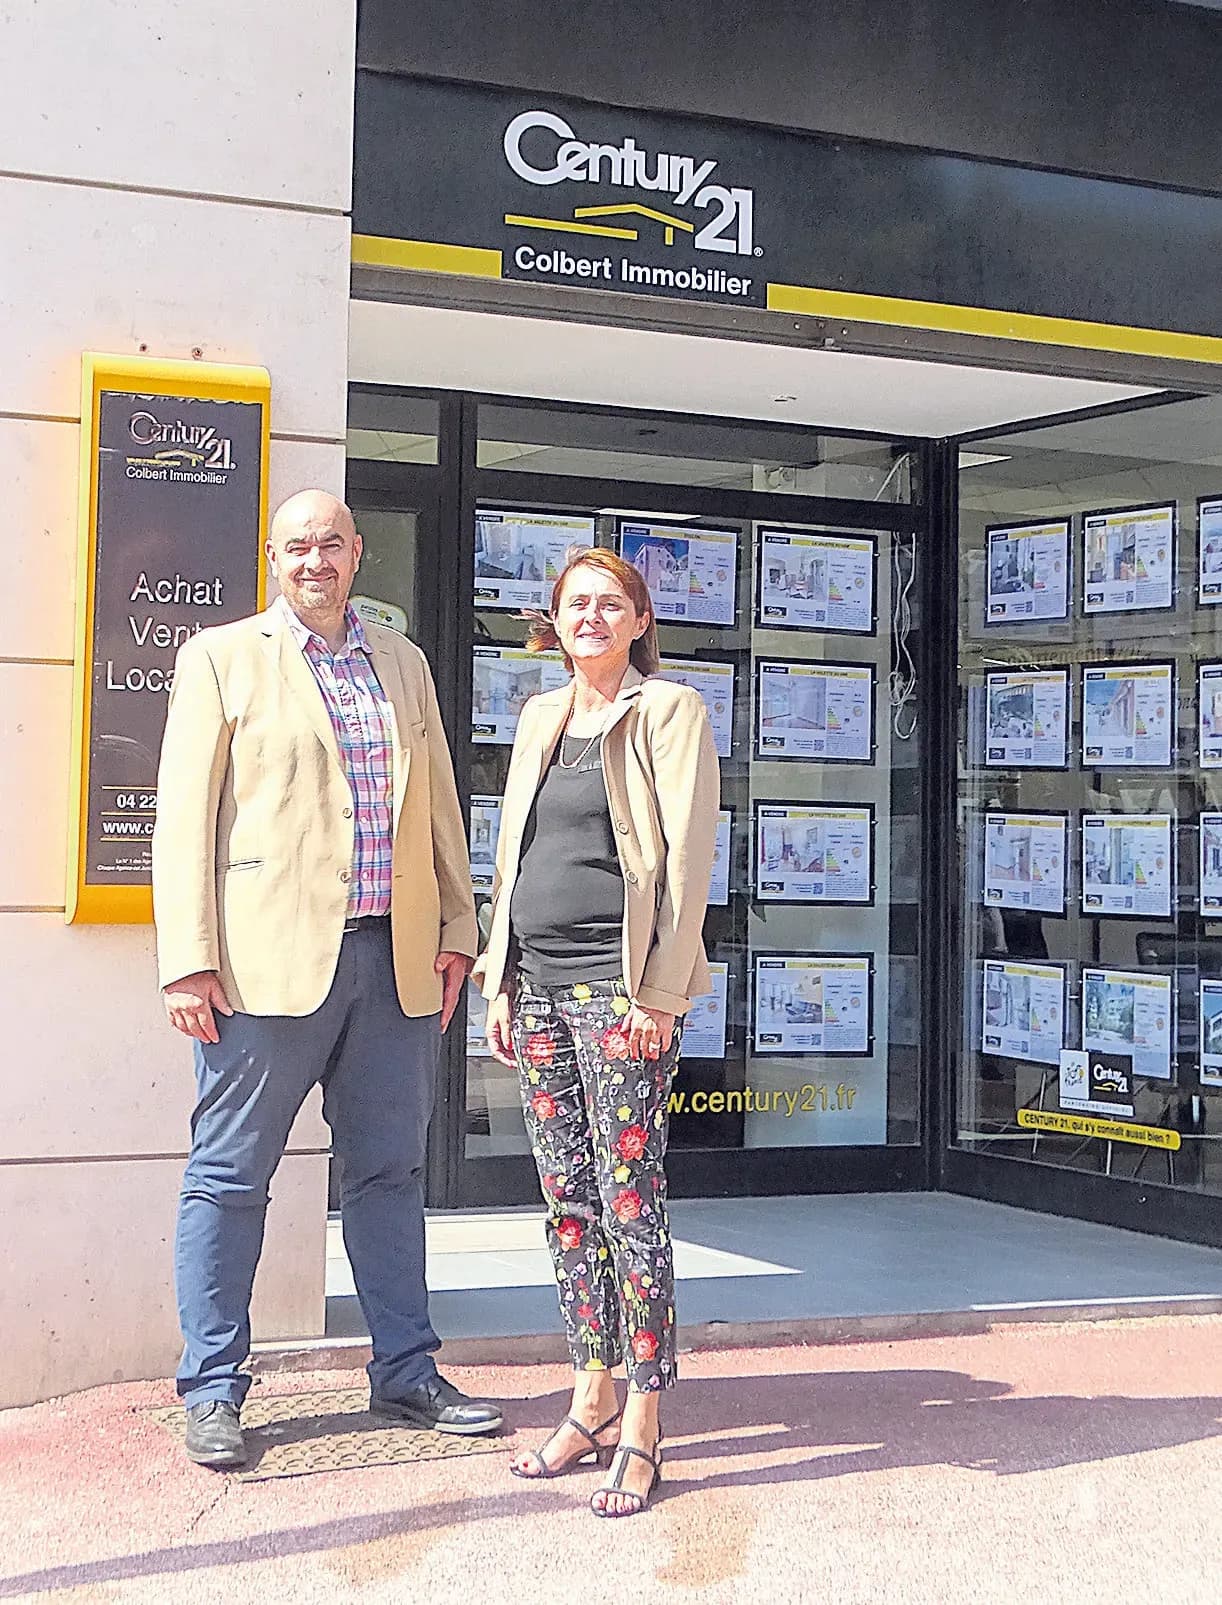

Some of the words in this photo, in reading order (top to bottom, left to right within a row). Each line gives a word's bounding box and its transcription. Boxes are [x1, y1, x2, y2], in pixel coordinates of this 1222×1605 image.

[504, 110, 717, 205] Century
[514, 246, 612, 280] Colbert
[621, 259, 752, 296] Immobilier
[130, 411, 216, 449] Century
[125, 466, 168, 481] Colbert
[169, 468, 229, 484] Immobilier
[130, 572, 224, 606] Achat
[116, 793, 136, 809] 04
[139, 794, 157, 809] 22
[102, 822, 154, 835] www.c
[1025, 1113, 1058, 1127] CENTURY
